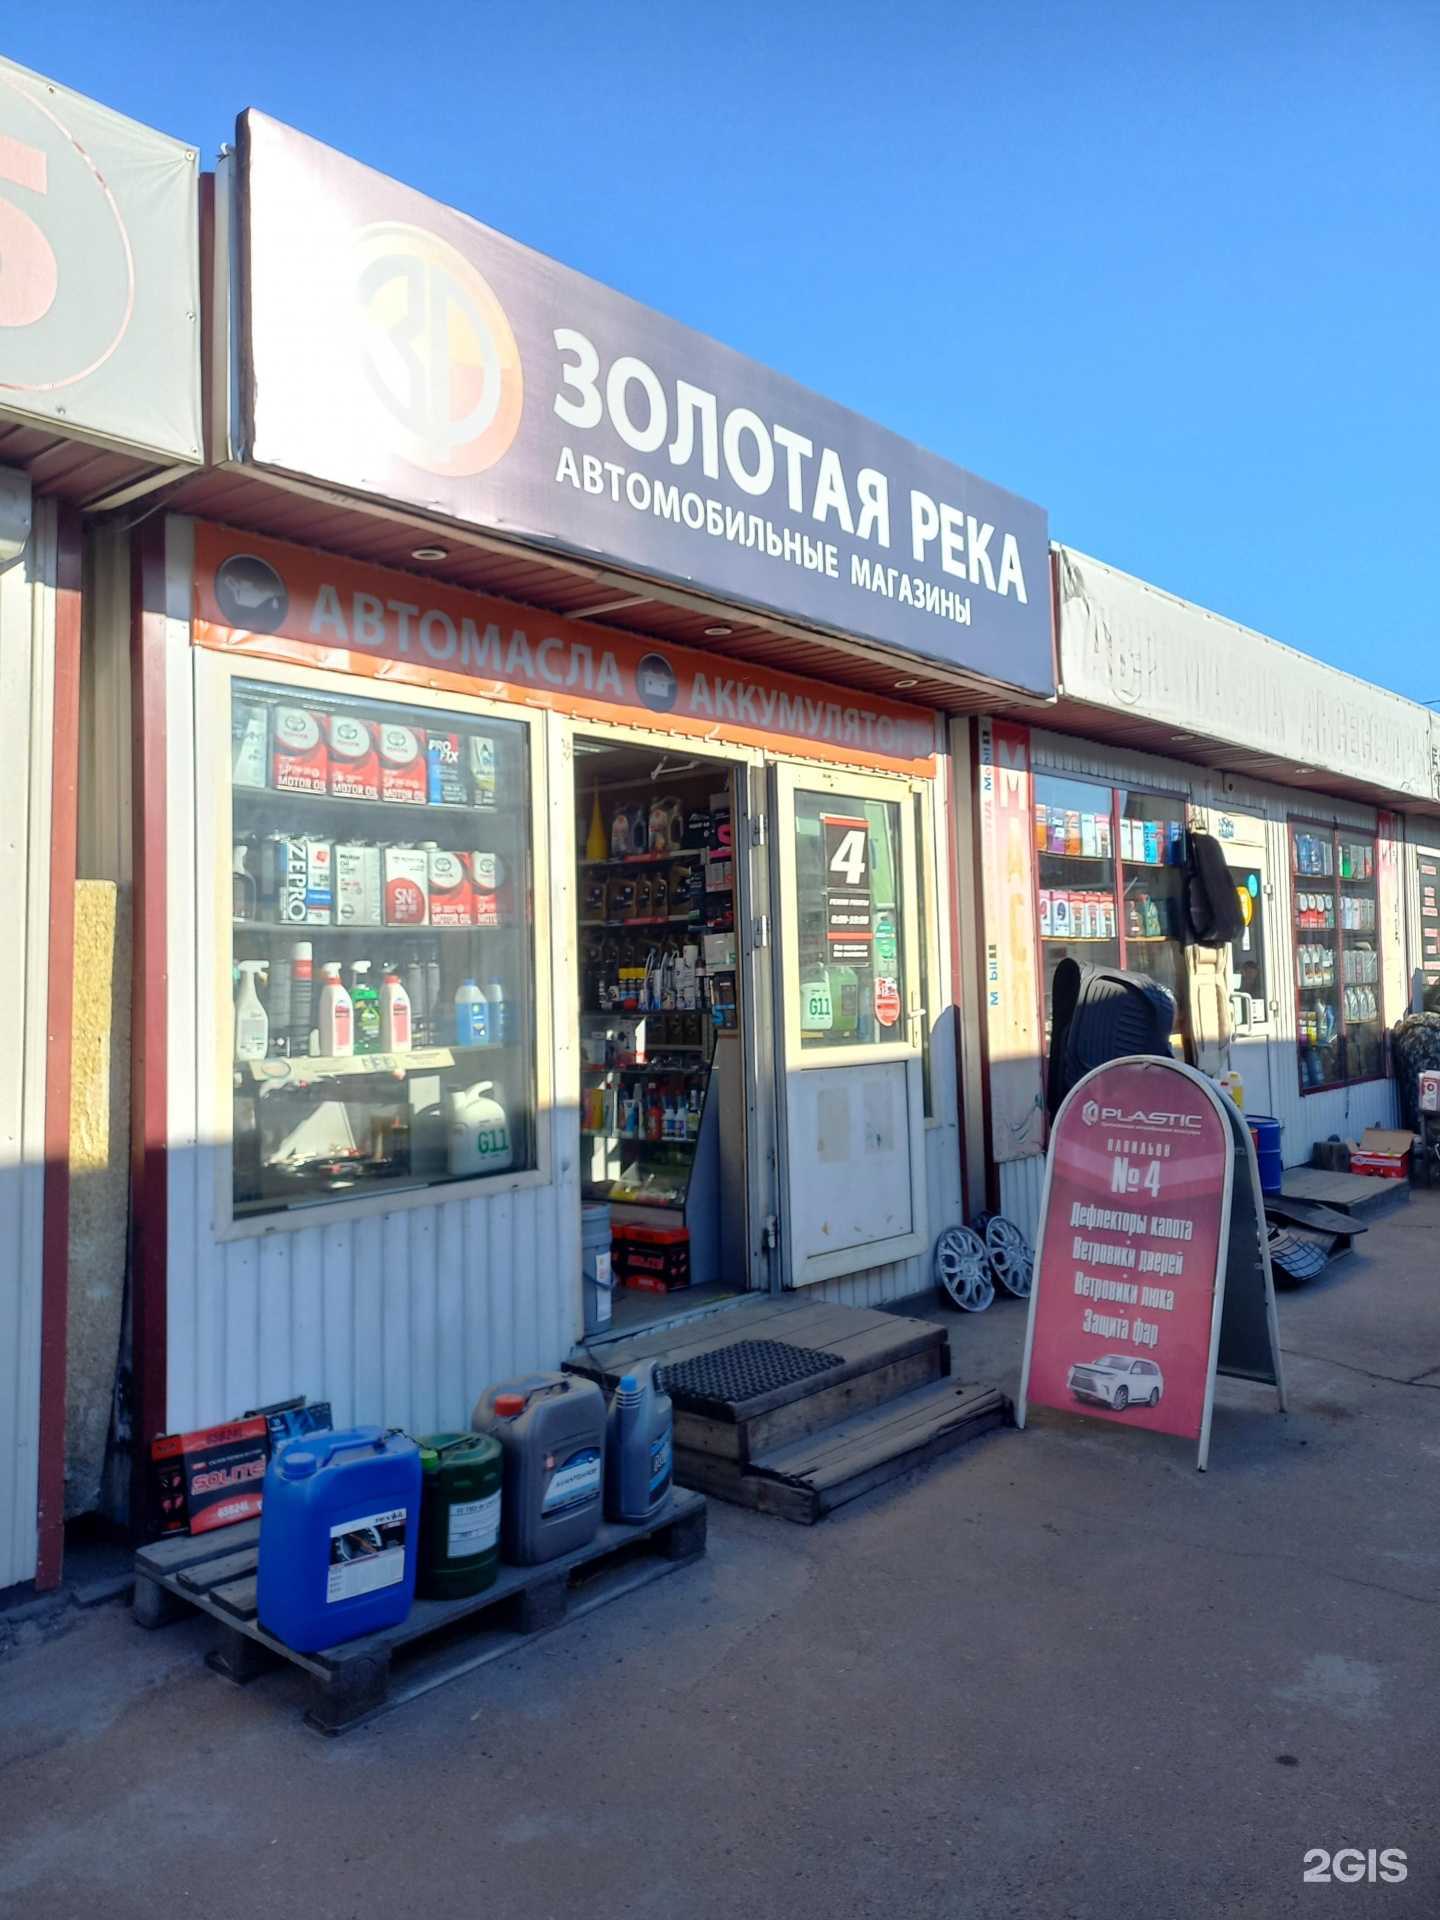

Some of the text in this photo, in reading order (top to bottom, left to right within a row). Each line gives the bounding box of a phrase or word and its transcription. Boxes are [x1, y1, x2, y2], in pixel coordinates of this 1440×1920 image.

[553, 328, 1028, 605] ЗОЛОТАЯ РЕКА
[555, 446, 971, 626] АВТОМОБИЛЬНЫЕ МАГАЗИНЫ
[309, 583, 624, 697] АВТОМАСЛА
[428, 739, 452, 751] PRO
[830, 830, 866, 884] 4
[287, 842, 307, 921] ZEPRO
[809, 998, 830, 1015] G11
[1101, 1108, 1202, 1129] PLASTIC
[478, 1129, 509, 1153] G11
[1070, 1202, 1193, 1240] Дефлекторы капота
[1072, 1236, 1184, 1277] Ветровики дверей
[1074, 1271, 1175, 1311] Ветровики люка
[1082, 1308, 1159, 1349] Защита фар
